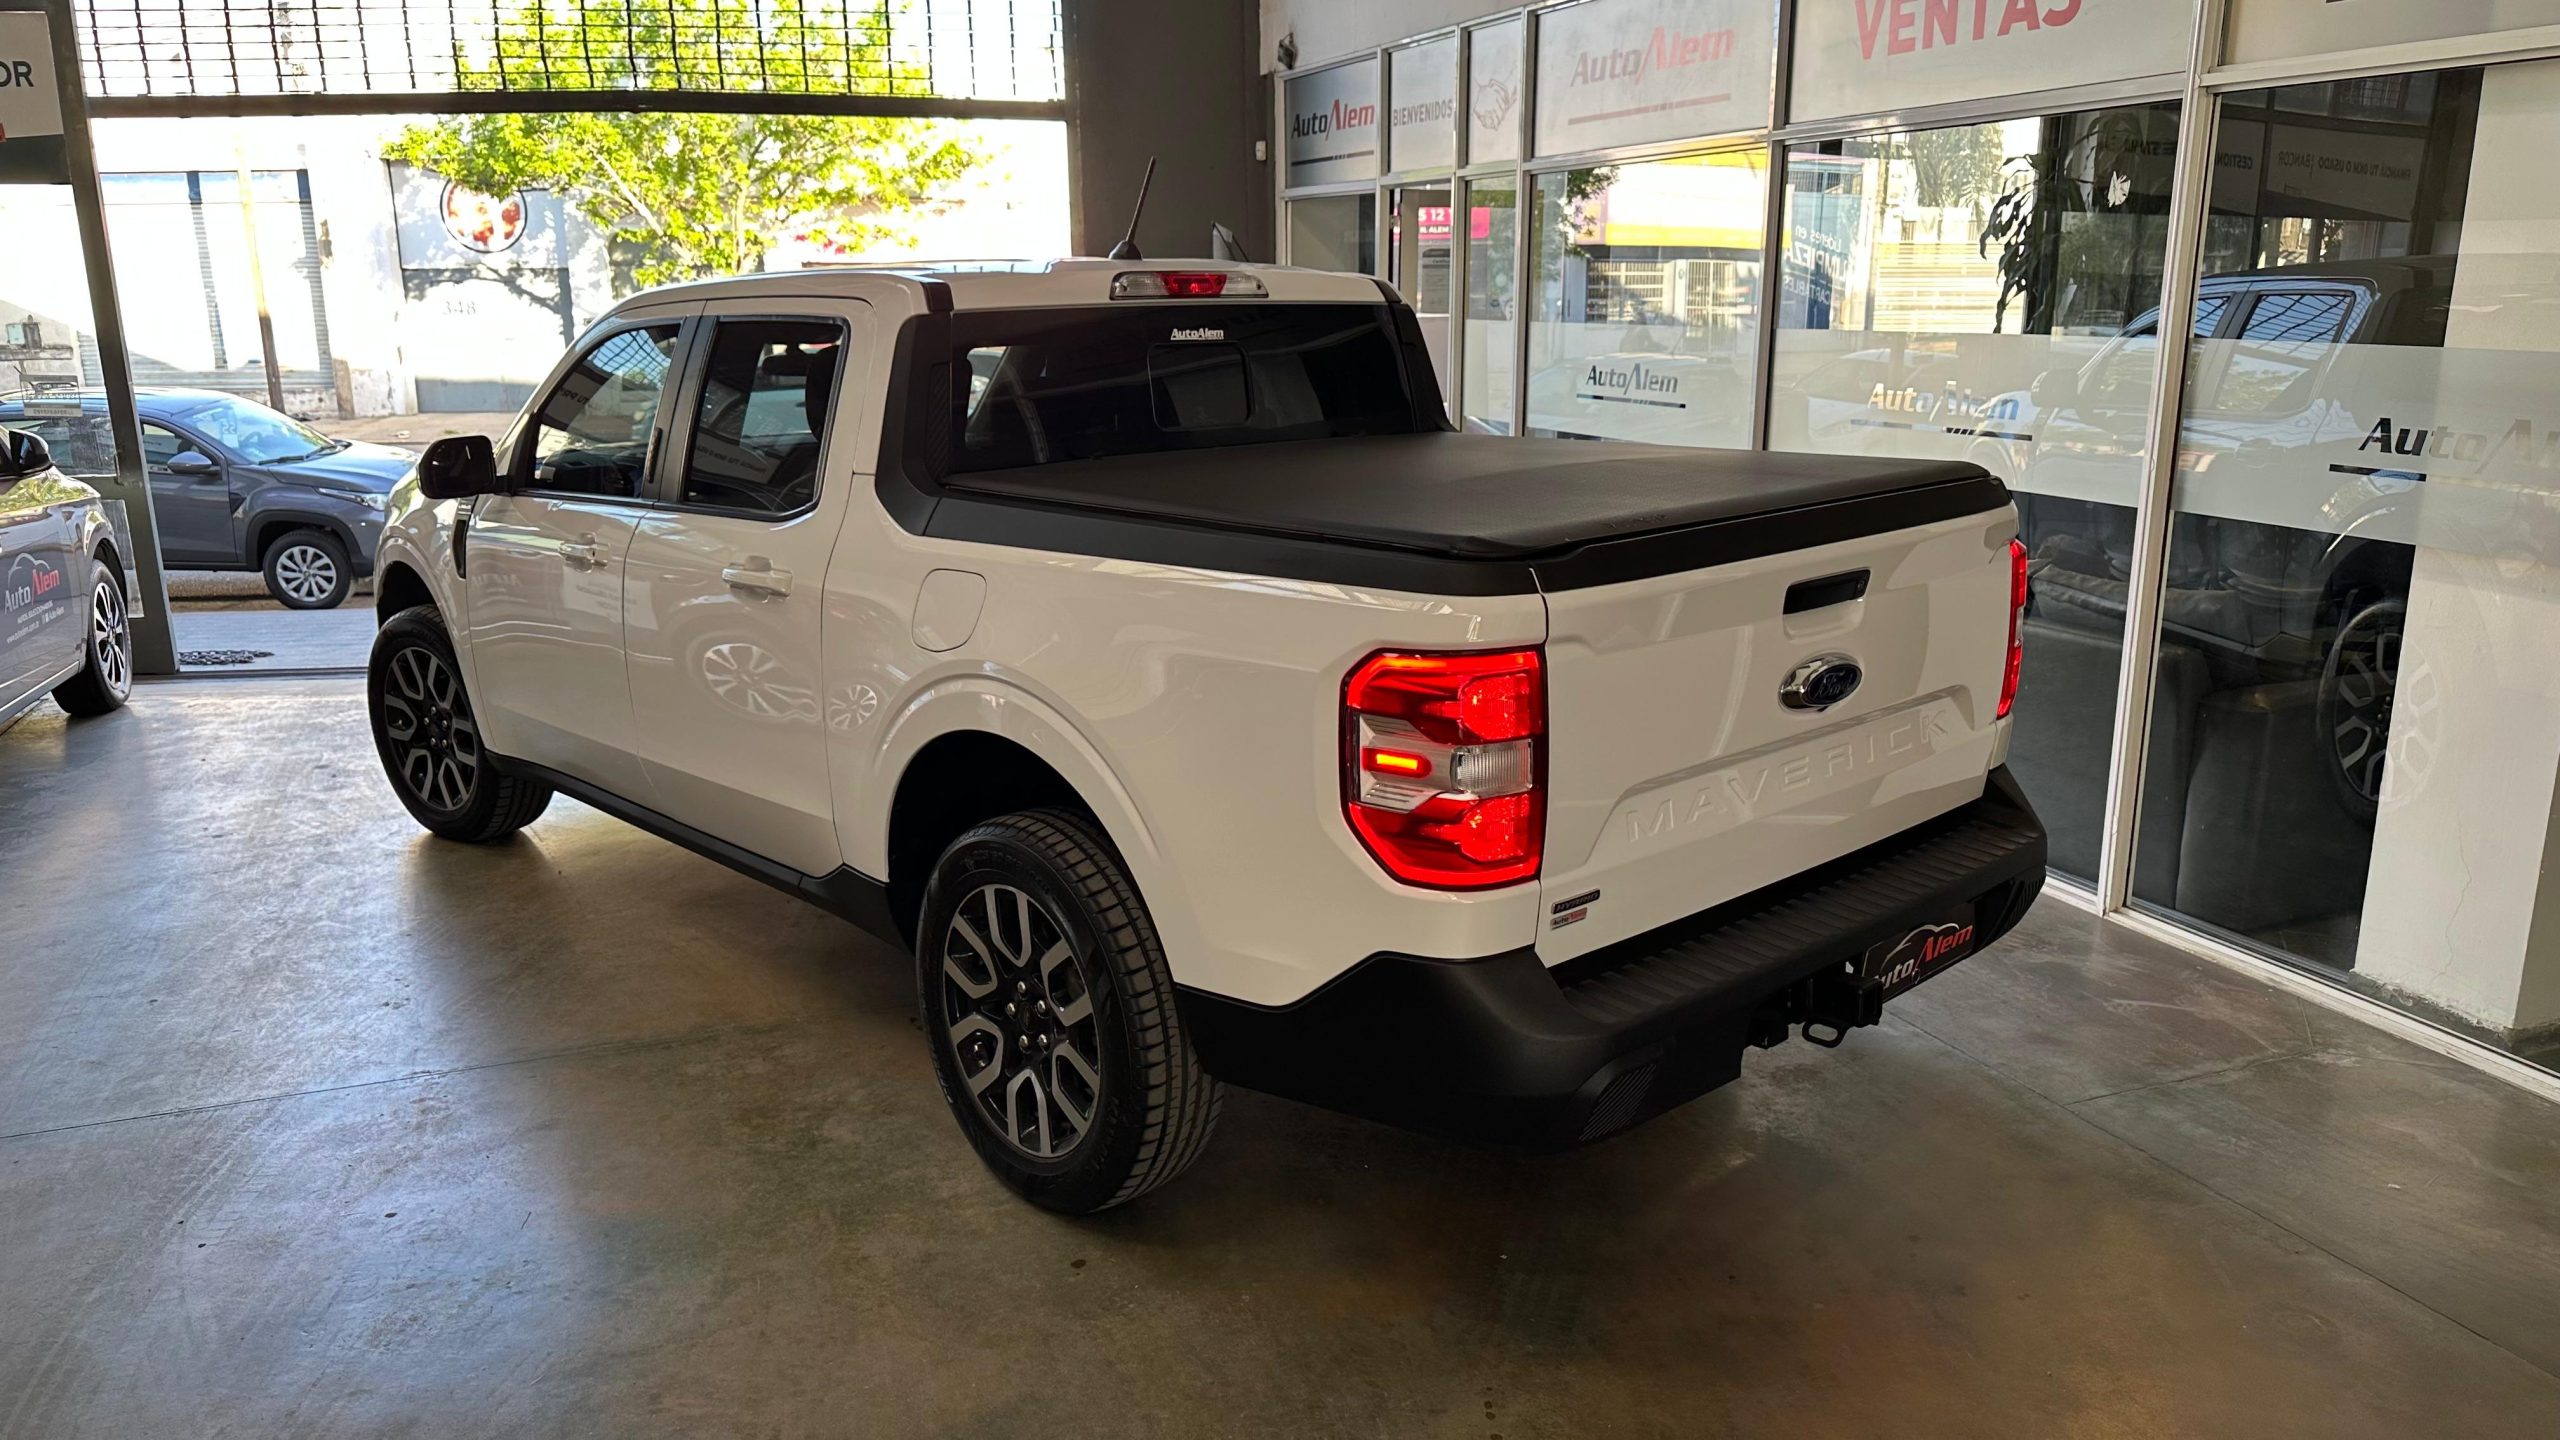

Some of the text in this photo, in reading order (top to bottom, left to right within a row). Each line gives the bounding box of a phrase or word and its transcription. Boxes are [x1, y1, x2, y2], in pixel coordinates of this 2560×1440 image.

[1291, 99, 1375, 142] AutoAlem
[1393, 99, 1453, 127] BIENVENIDOS
[1586, 363, 1678, 395] AutoAlem
[1625, 709, 1950, 843] MAVERICK
[1875, 925, 1974, 989] utoAlem
